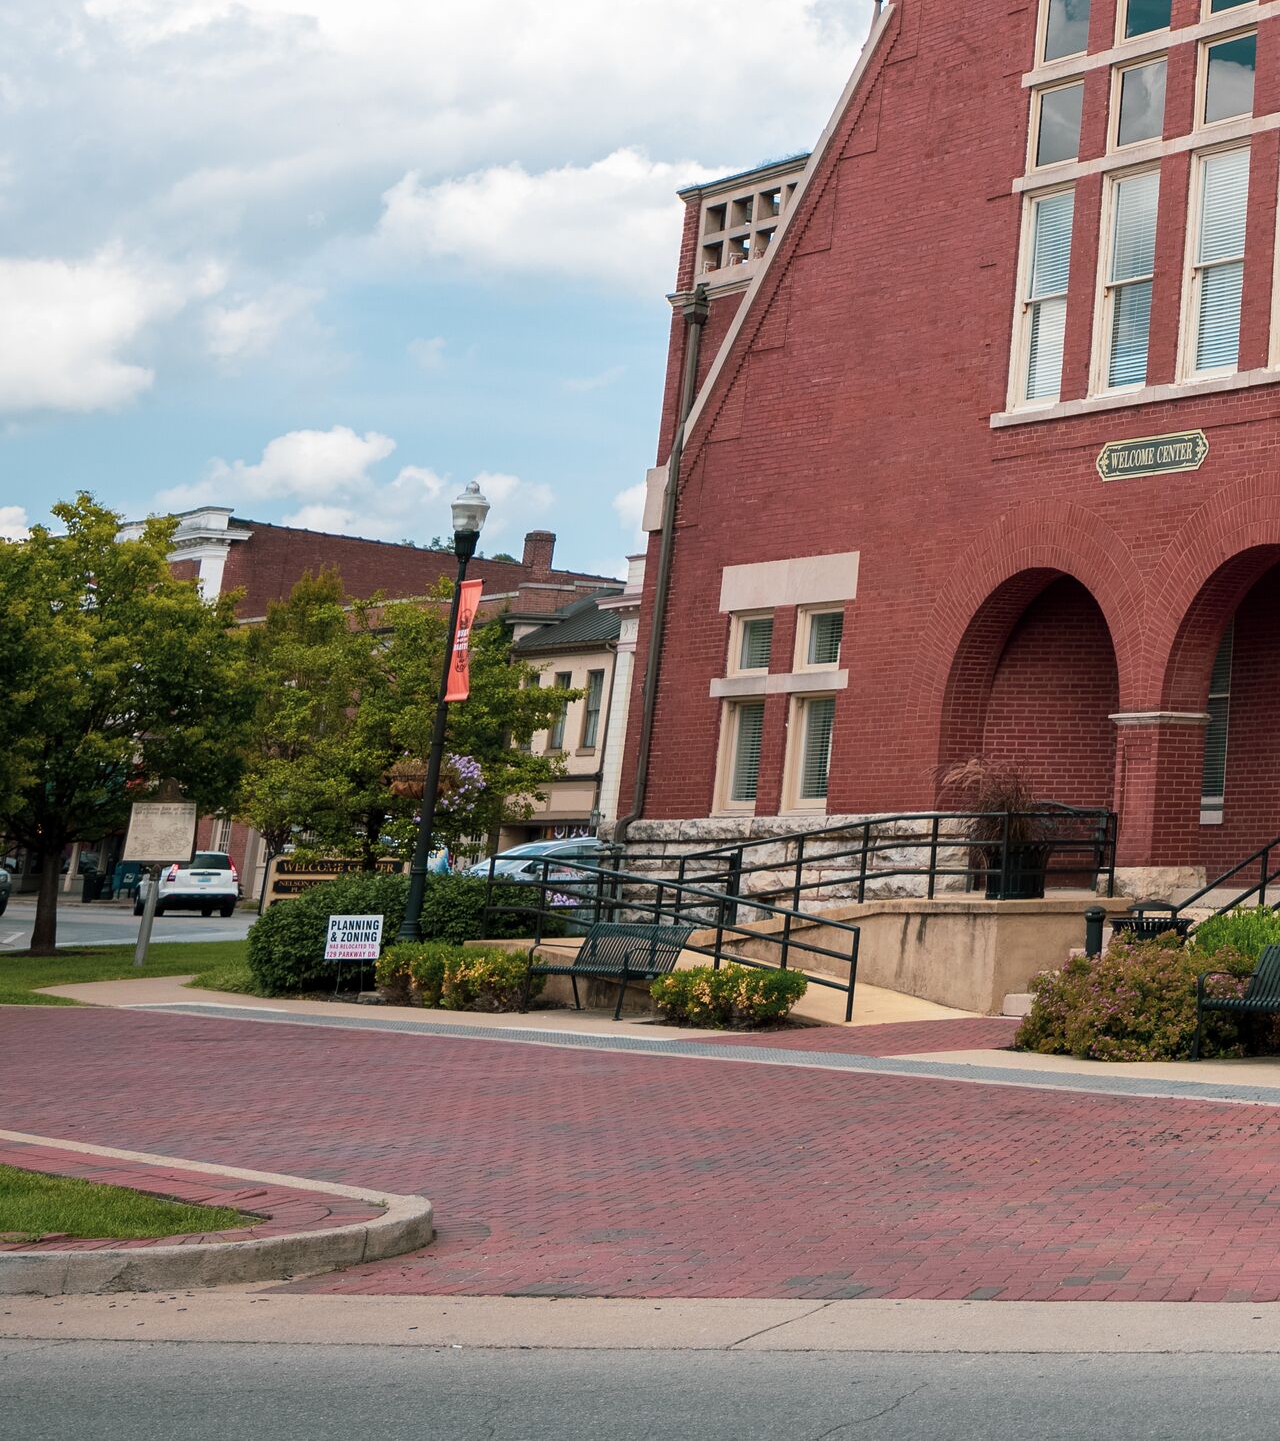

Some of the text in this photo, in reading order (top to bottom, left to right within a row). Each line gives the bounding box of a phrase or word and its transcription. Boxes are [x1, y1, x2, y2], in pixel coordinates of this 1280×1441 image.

[1111, 442, 1193, 469] WELCOME CENTER
[331, 920, 380, 930] PLANNING
[330, 932, 378, 942] & ZONING
